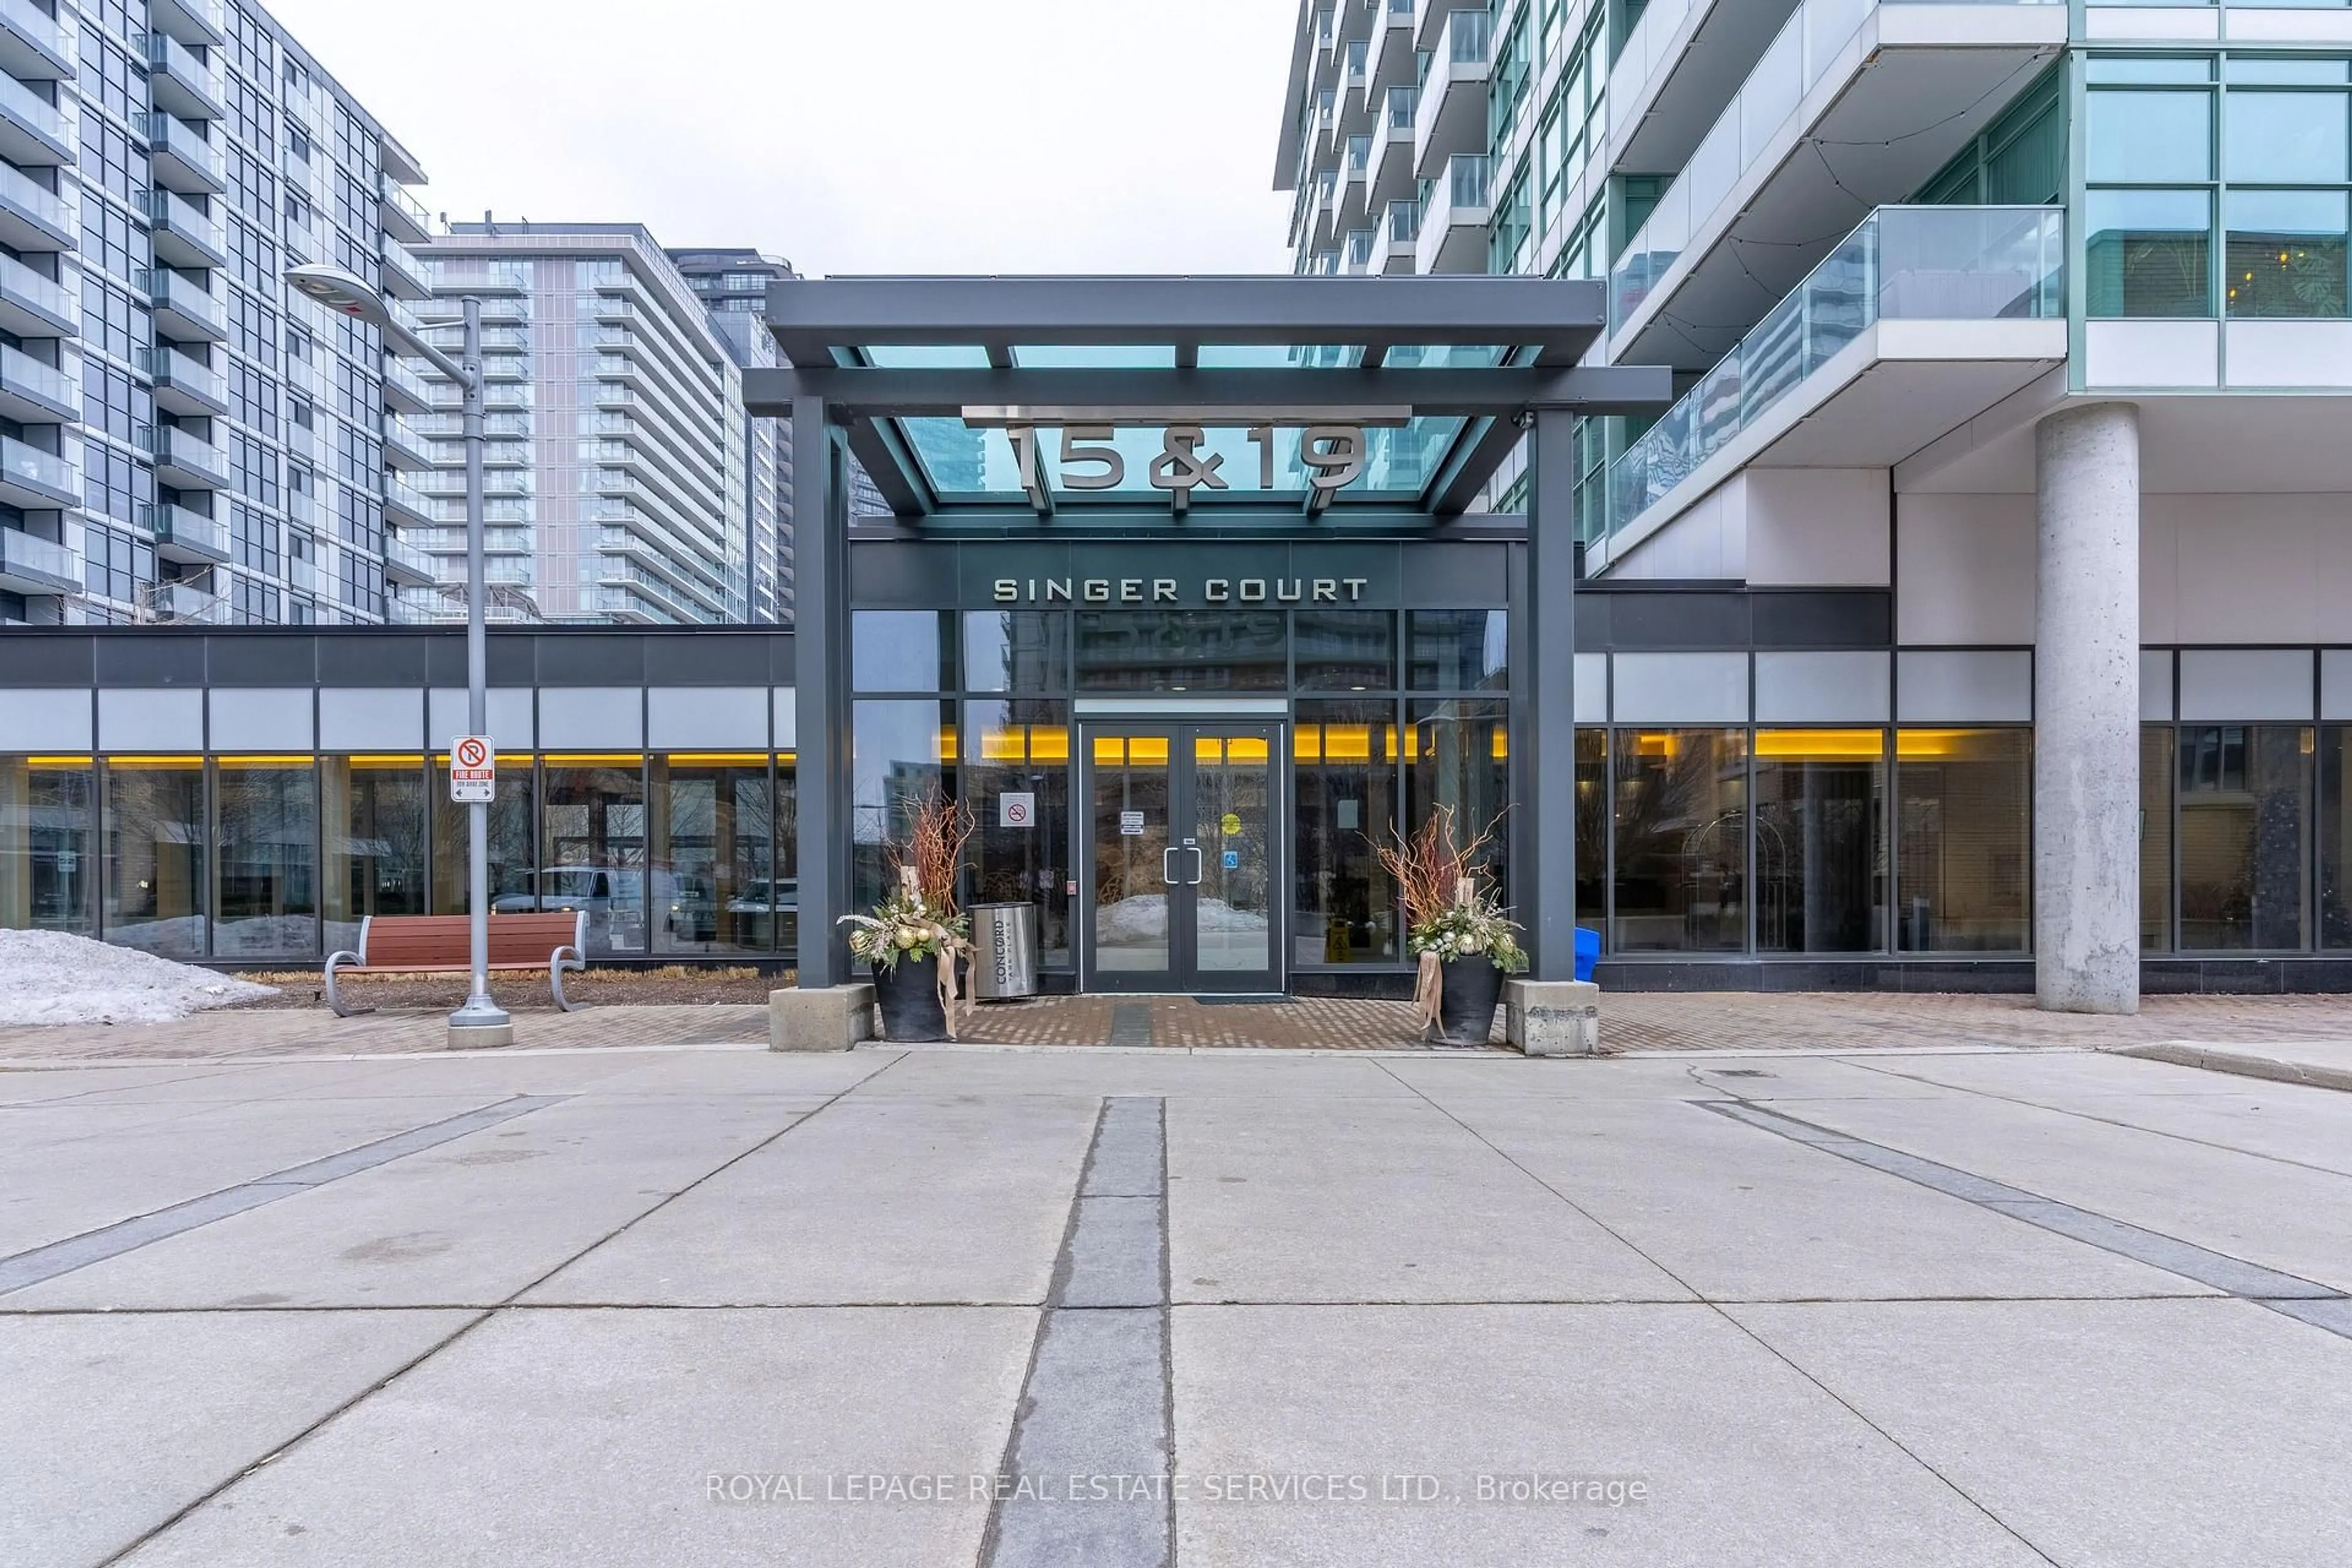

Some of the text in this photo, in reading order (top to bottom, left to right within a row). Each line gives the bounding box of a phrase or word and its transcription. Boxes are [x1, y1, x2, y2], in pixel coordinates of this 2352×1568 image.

[1008, 426, 1366, 489] 15 & 19
[993, 578, 1367, 601] SINGER COURT
[455, 770, 489, 778] FIRE ROUTE
